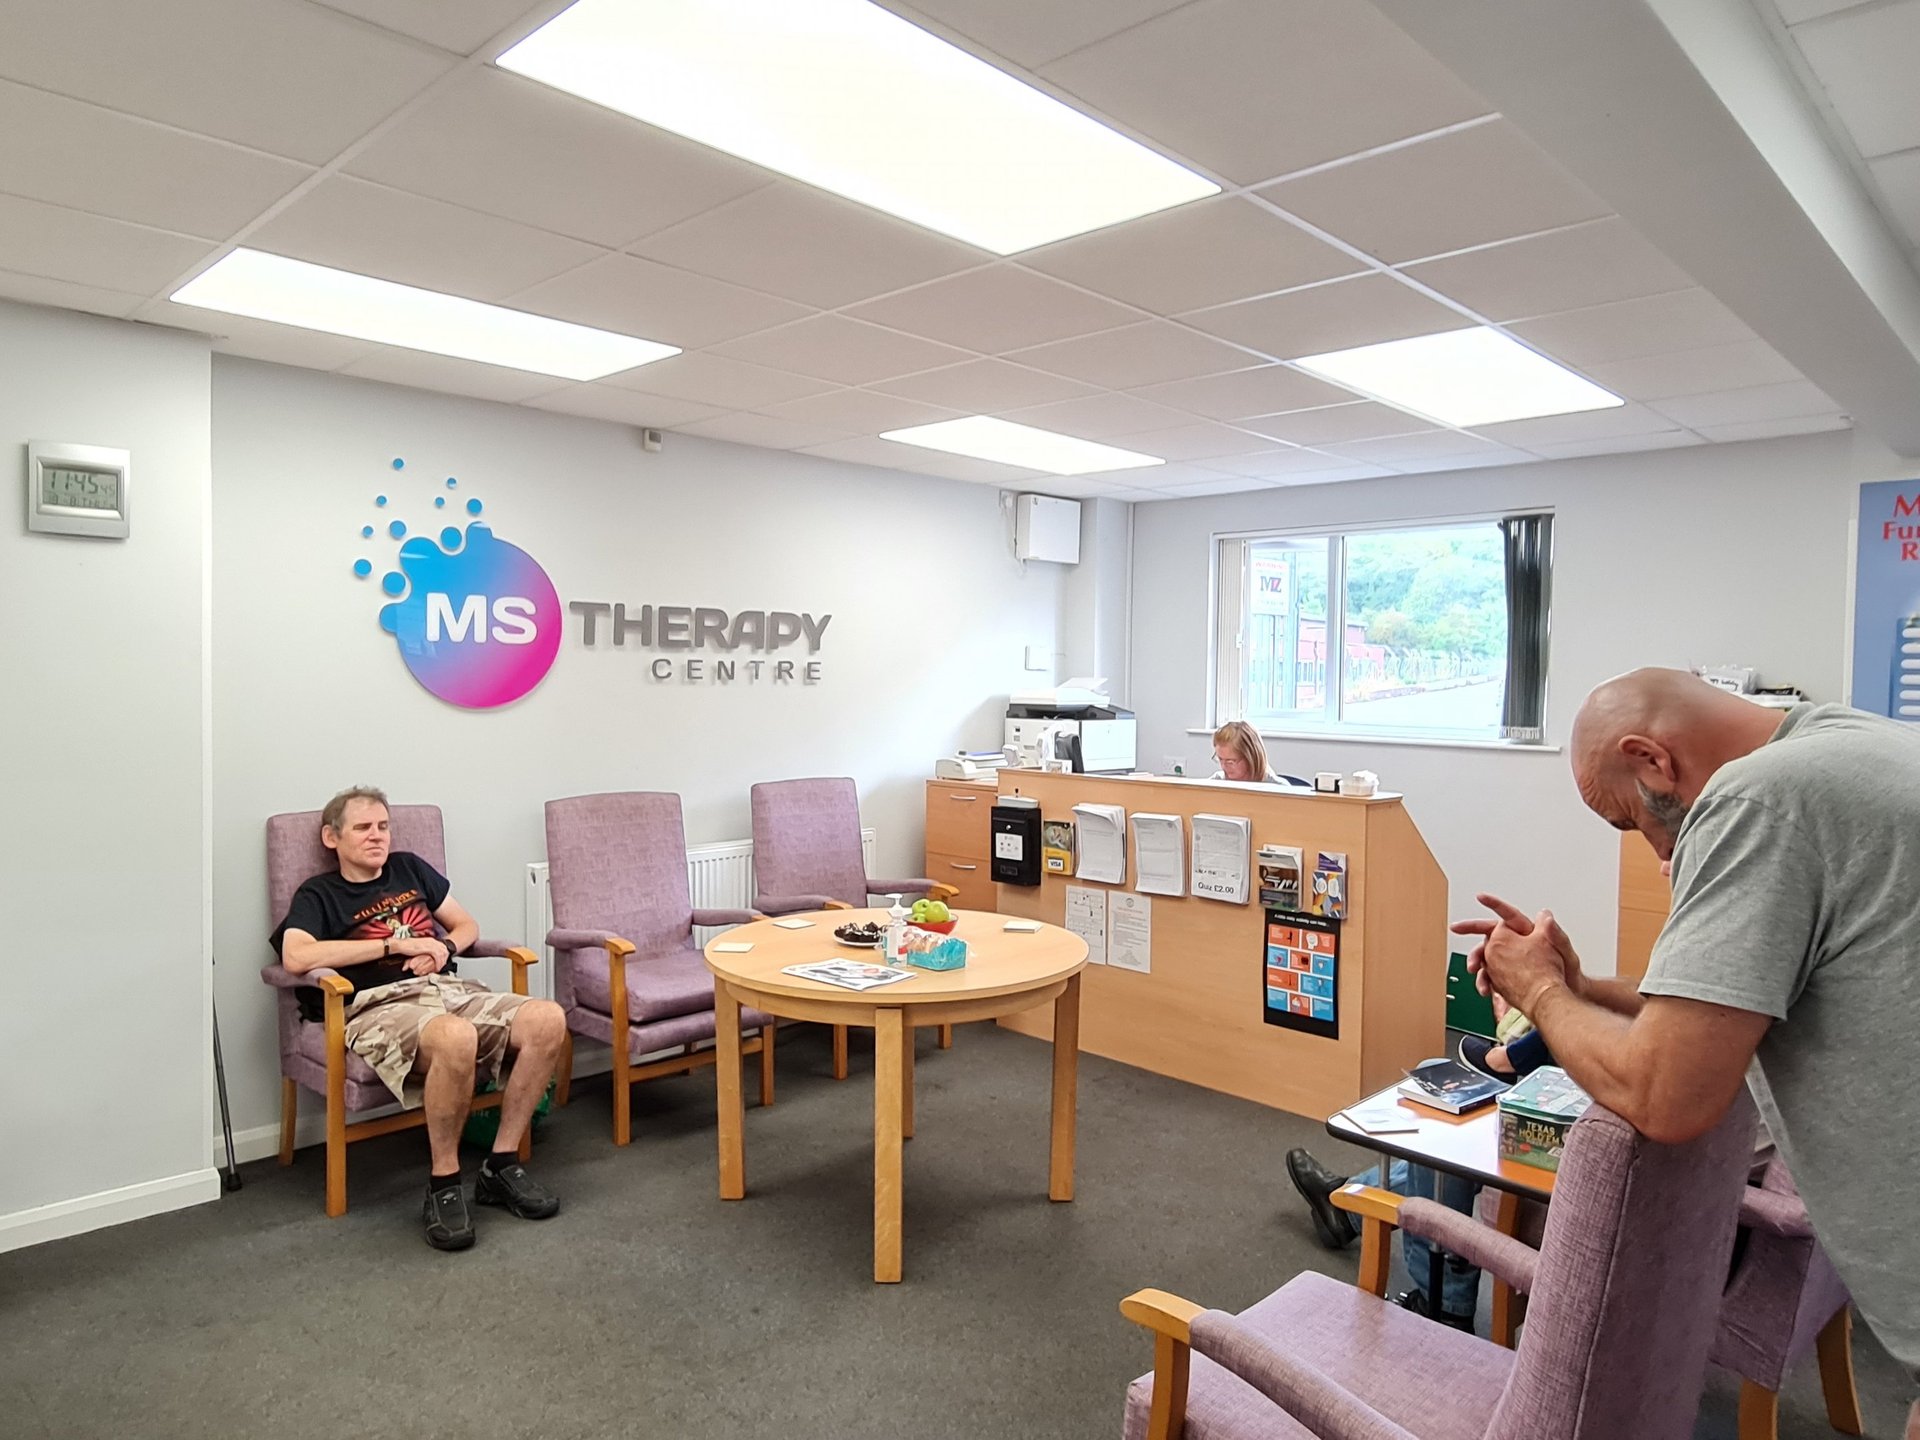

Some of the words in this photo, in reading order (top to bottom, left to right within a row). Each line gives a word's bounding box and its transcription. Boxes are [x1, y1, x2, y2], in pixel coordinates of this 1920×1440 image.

[51, 471, 98, 494] 11:45
[425, 592, 538, 645] MS
[568, 600, 832, 652] THERAPY
[651, 658, 822, 682] CENTRE
[1198, 881, 1212, 891] Quiz
[1214, 884, 1234, 894] £2.00
[1526, 1121, 1555, 1136] TEXAS
